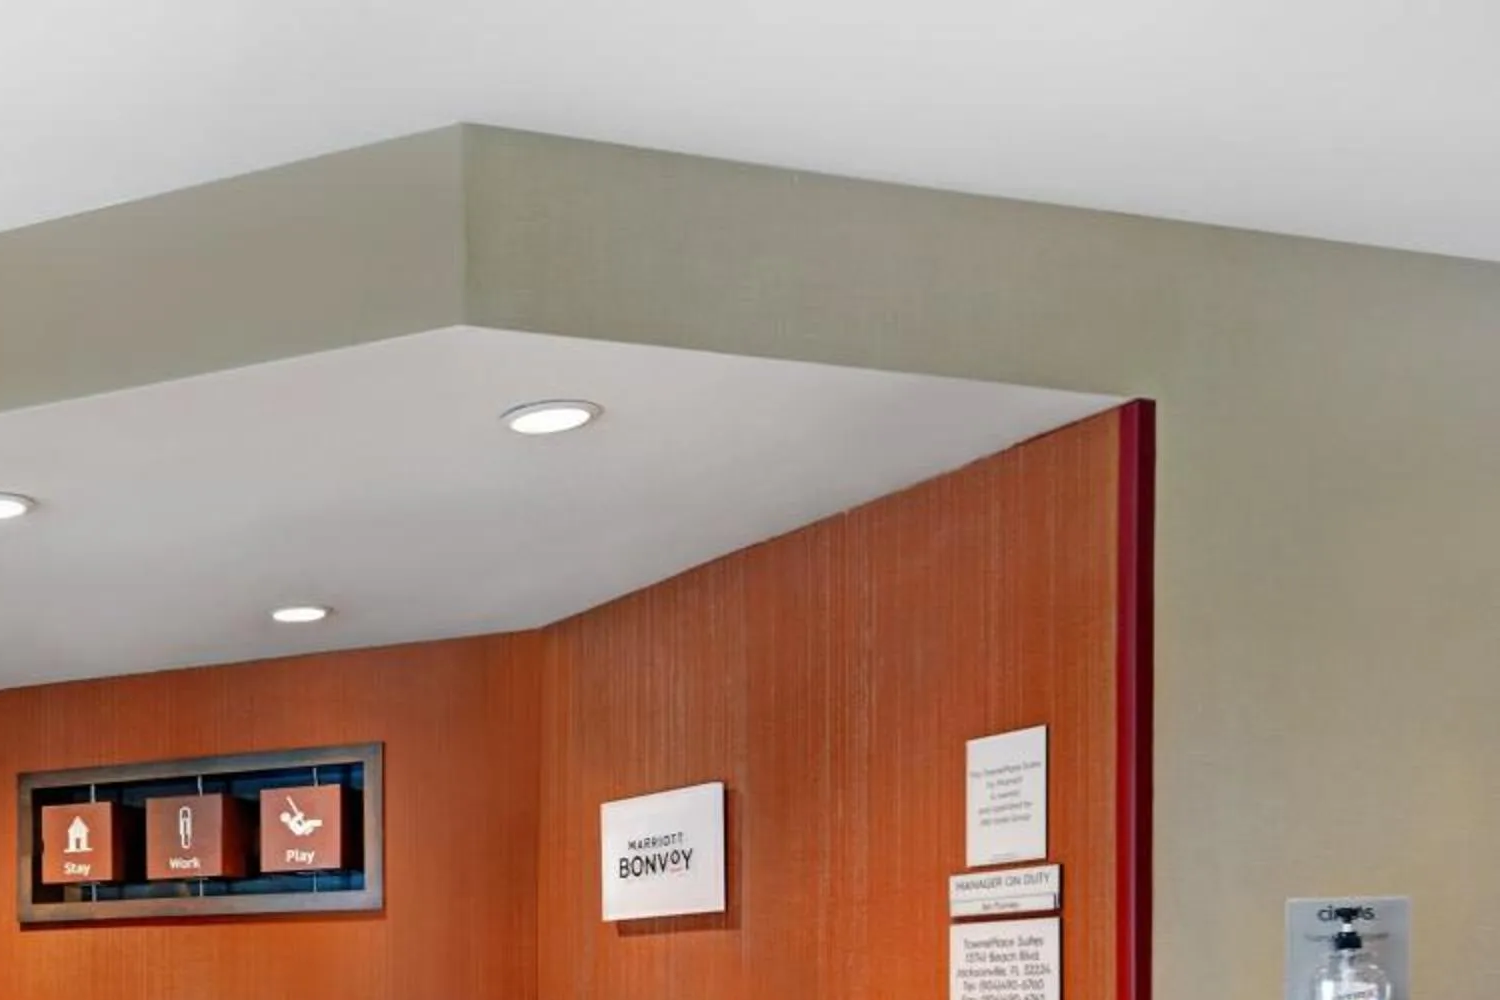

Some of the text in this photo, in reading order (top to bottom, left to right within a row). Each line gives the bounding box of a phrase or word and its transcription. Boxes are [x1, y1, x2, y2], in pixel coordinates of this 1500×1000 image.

[628, 832, 683, 850] MARRIOTT
[169, 857, 200, 870] Work
[286, 849, 315, 865] Play
[619, 848, 693, 879] BONVOY
[63, 861, 91, 876] Stay
[955, 876, 1002, 891] MANAGER
[1024, 872, 1051, 885] DUTY
